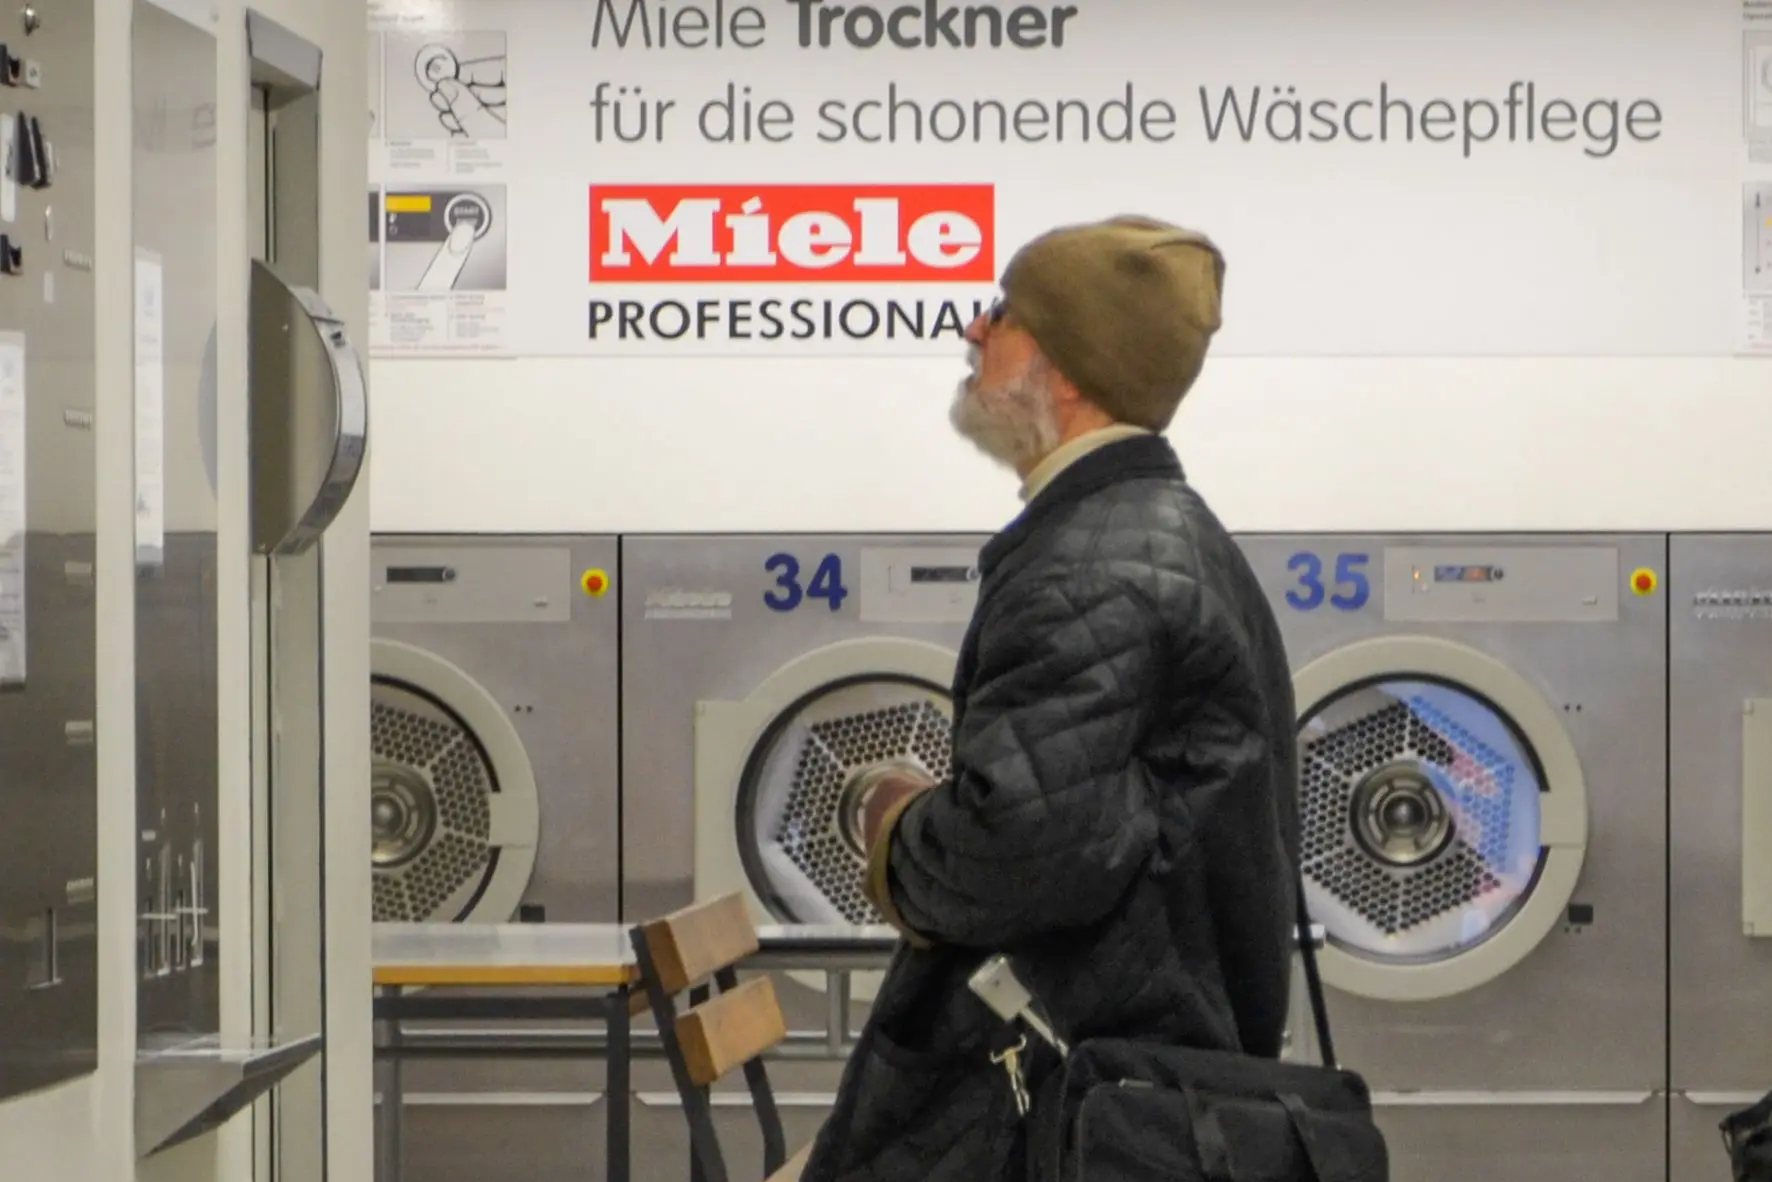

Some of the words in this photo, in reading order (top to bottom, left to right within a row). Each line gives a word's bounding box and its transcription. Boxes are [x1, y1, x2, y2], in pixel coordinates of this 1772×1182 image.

[590, 0, 767, 49] Miele
[786, 0, 1079, 50] Trockner
[589, 80, 676, 142] für
[698, 81, 795, 142] die
[816, 80, 1177, 142] schonende
[1198, 80, 1662, 157] Wäschepflege
[601, 195, 983, 268] Miele
[764, 553, 847, 611] 34
[1285, 552, 1371, 611] 35
